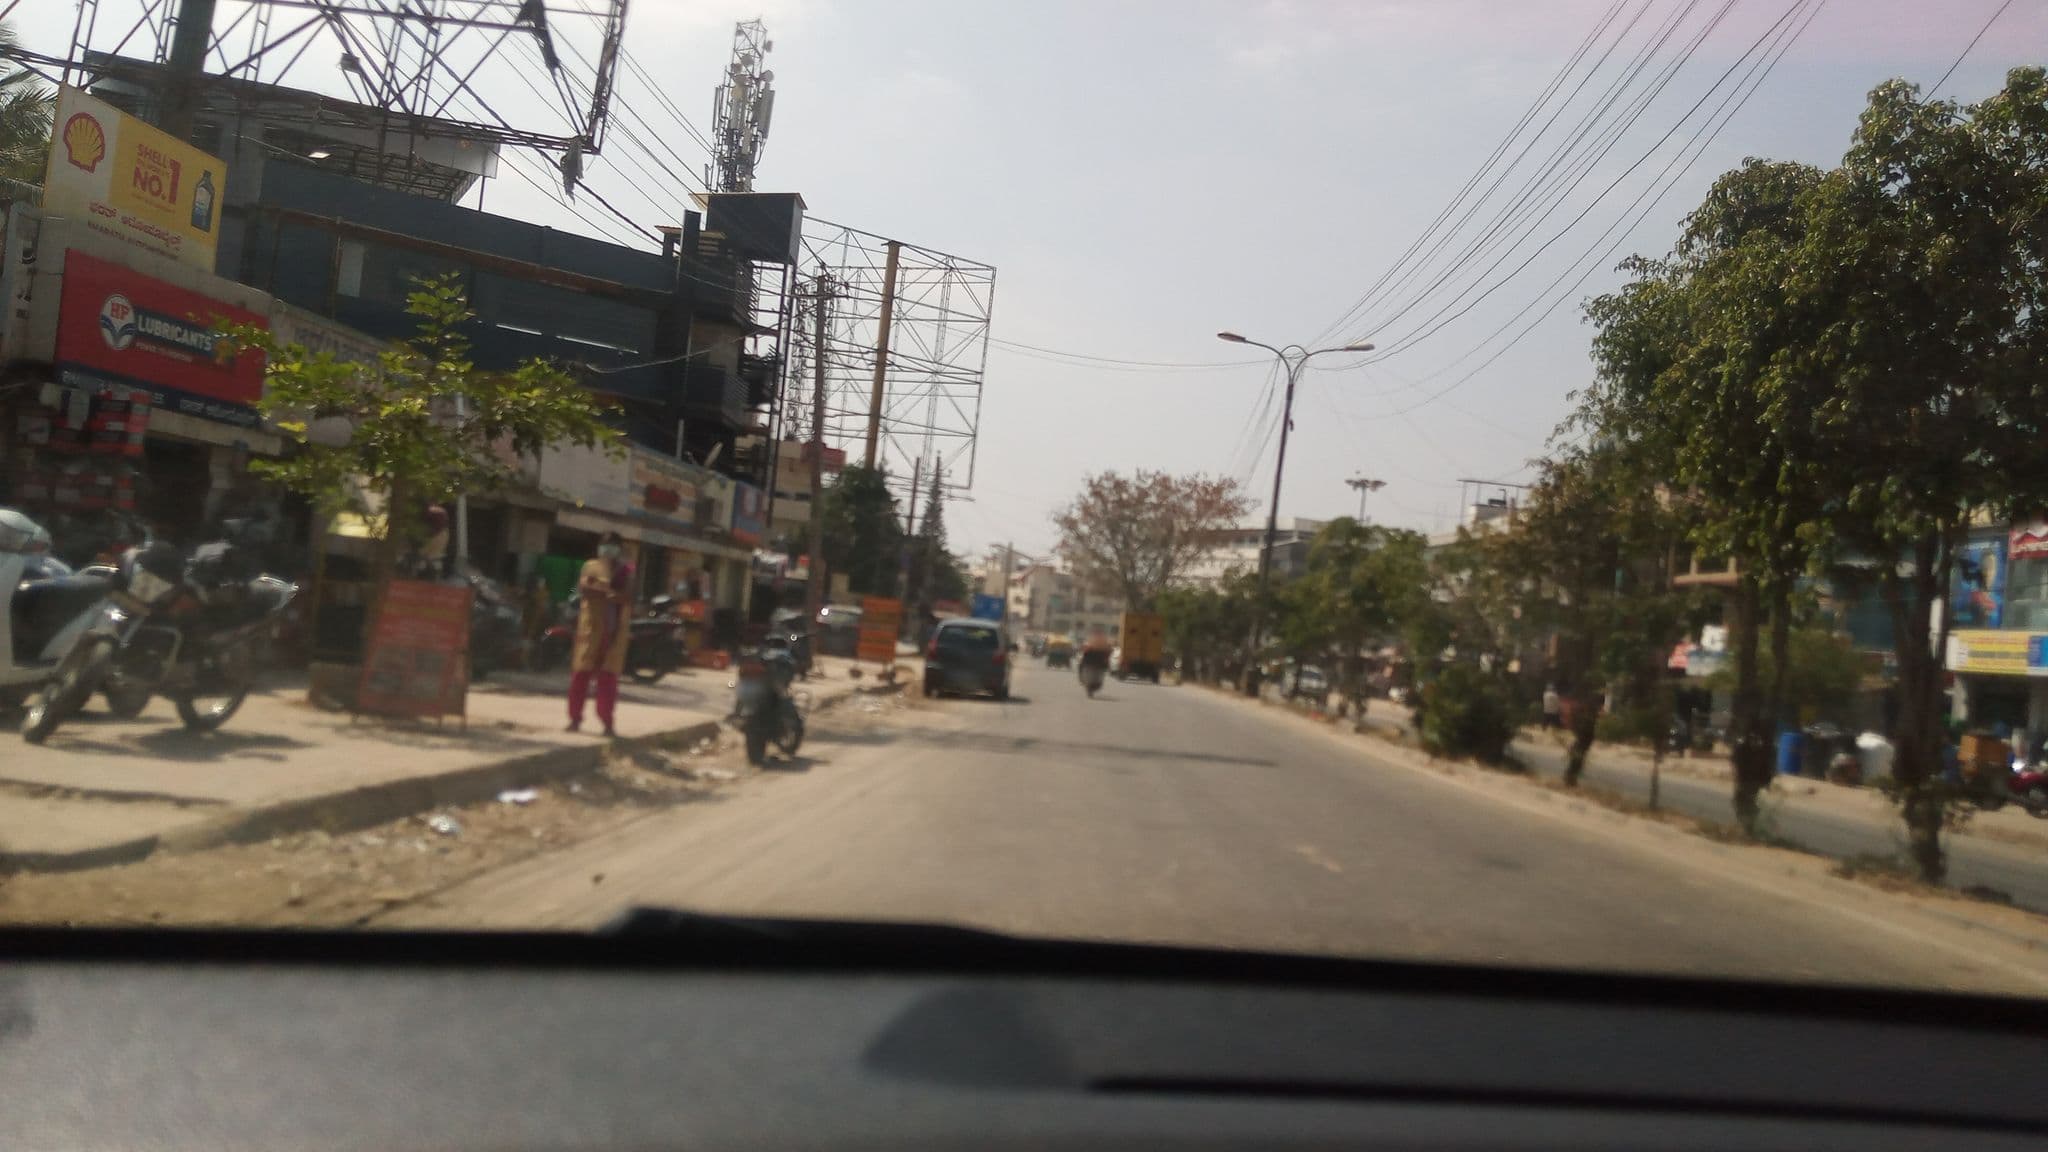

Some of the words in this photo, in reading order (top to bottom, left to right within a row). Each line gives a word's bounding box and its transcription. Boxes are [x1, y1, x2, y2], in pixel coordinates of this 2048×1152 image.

[137, 144, 167, 168] SHELL
[111, 302, 129, 320] HP
[138, 314, 212, 351] LUBRICANTS
